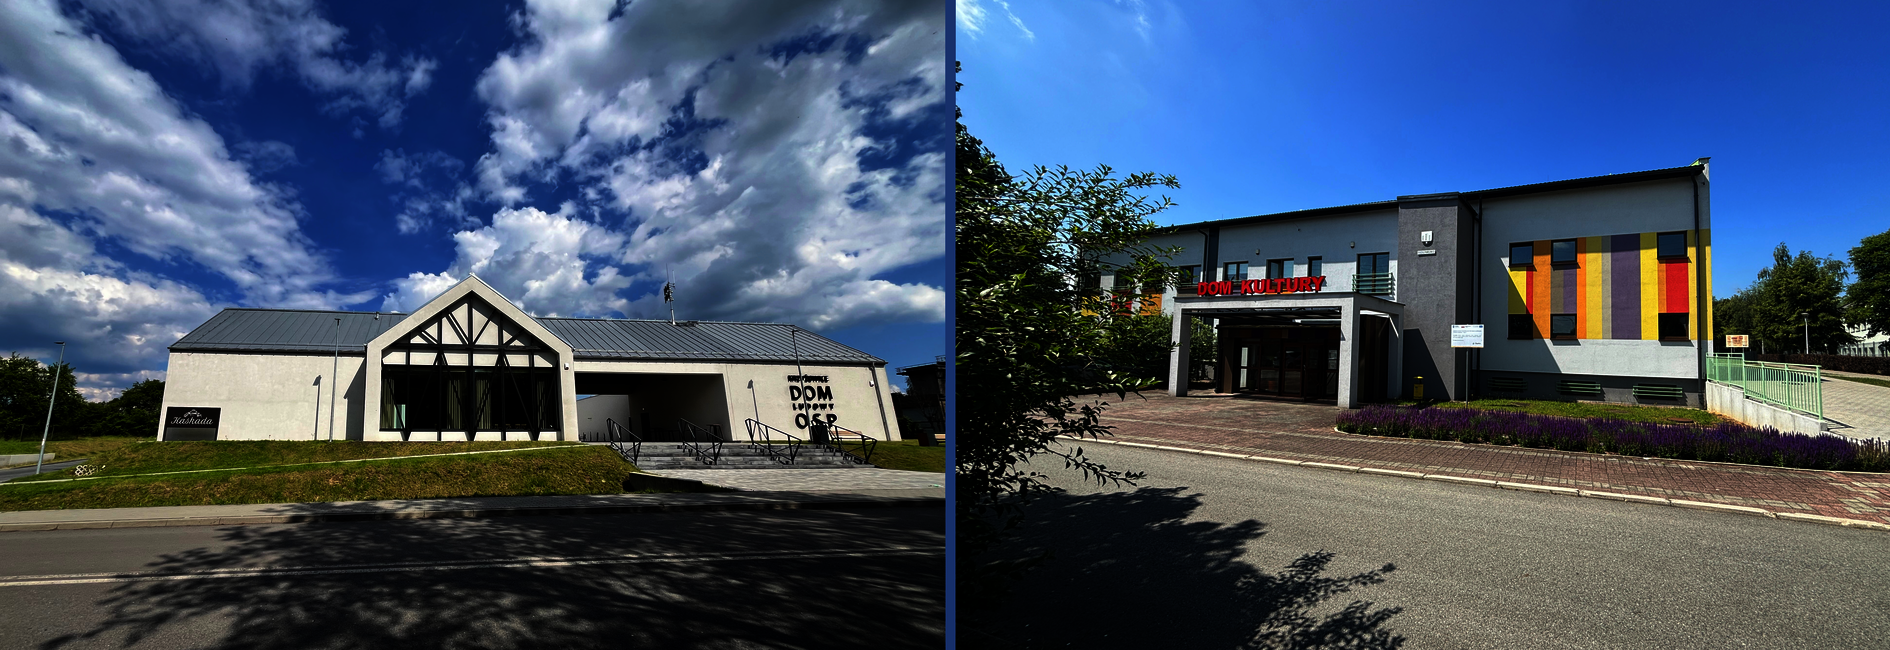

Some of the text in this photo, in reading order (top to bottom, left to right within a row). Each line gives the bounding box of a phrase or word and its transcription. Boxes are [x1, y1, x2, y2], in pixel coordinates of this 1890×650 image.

[1197, 276, 1326, 295] DOM KULTURY
[789, 385, 833, 401] DOM
[170, 416, 213, 424] Kaskada
